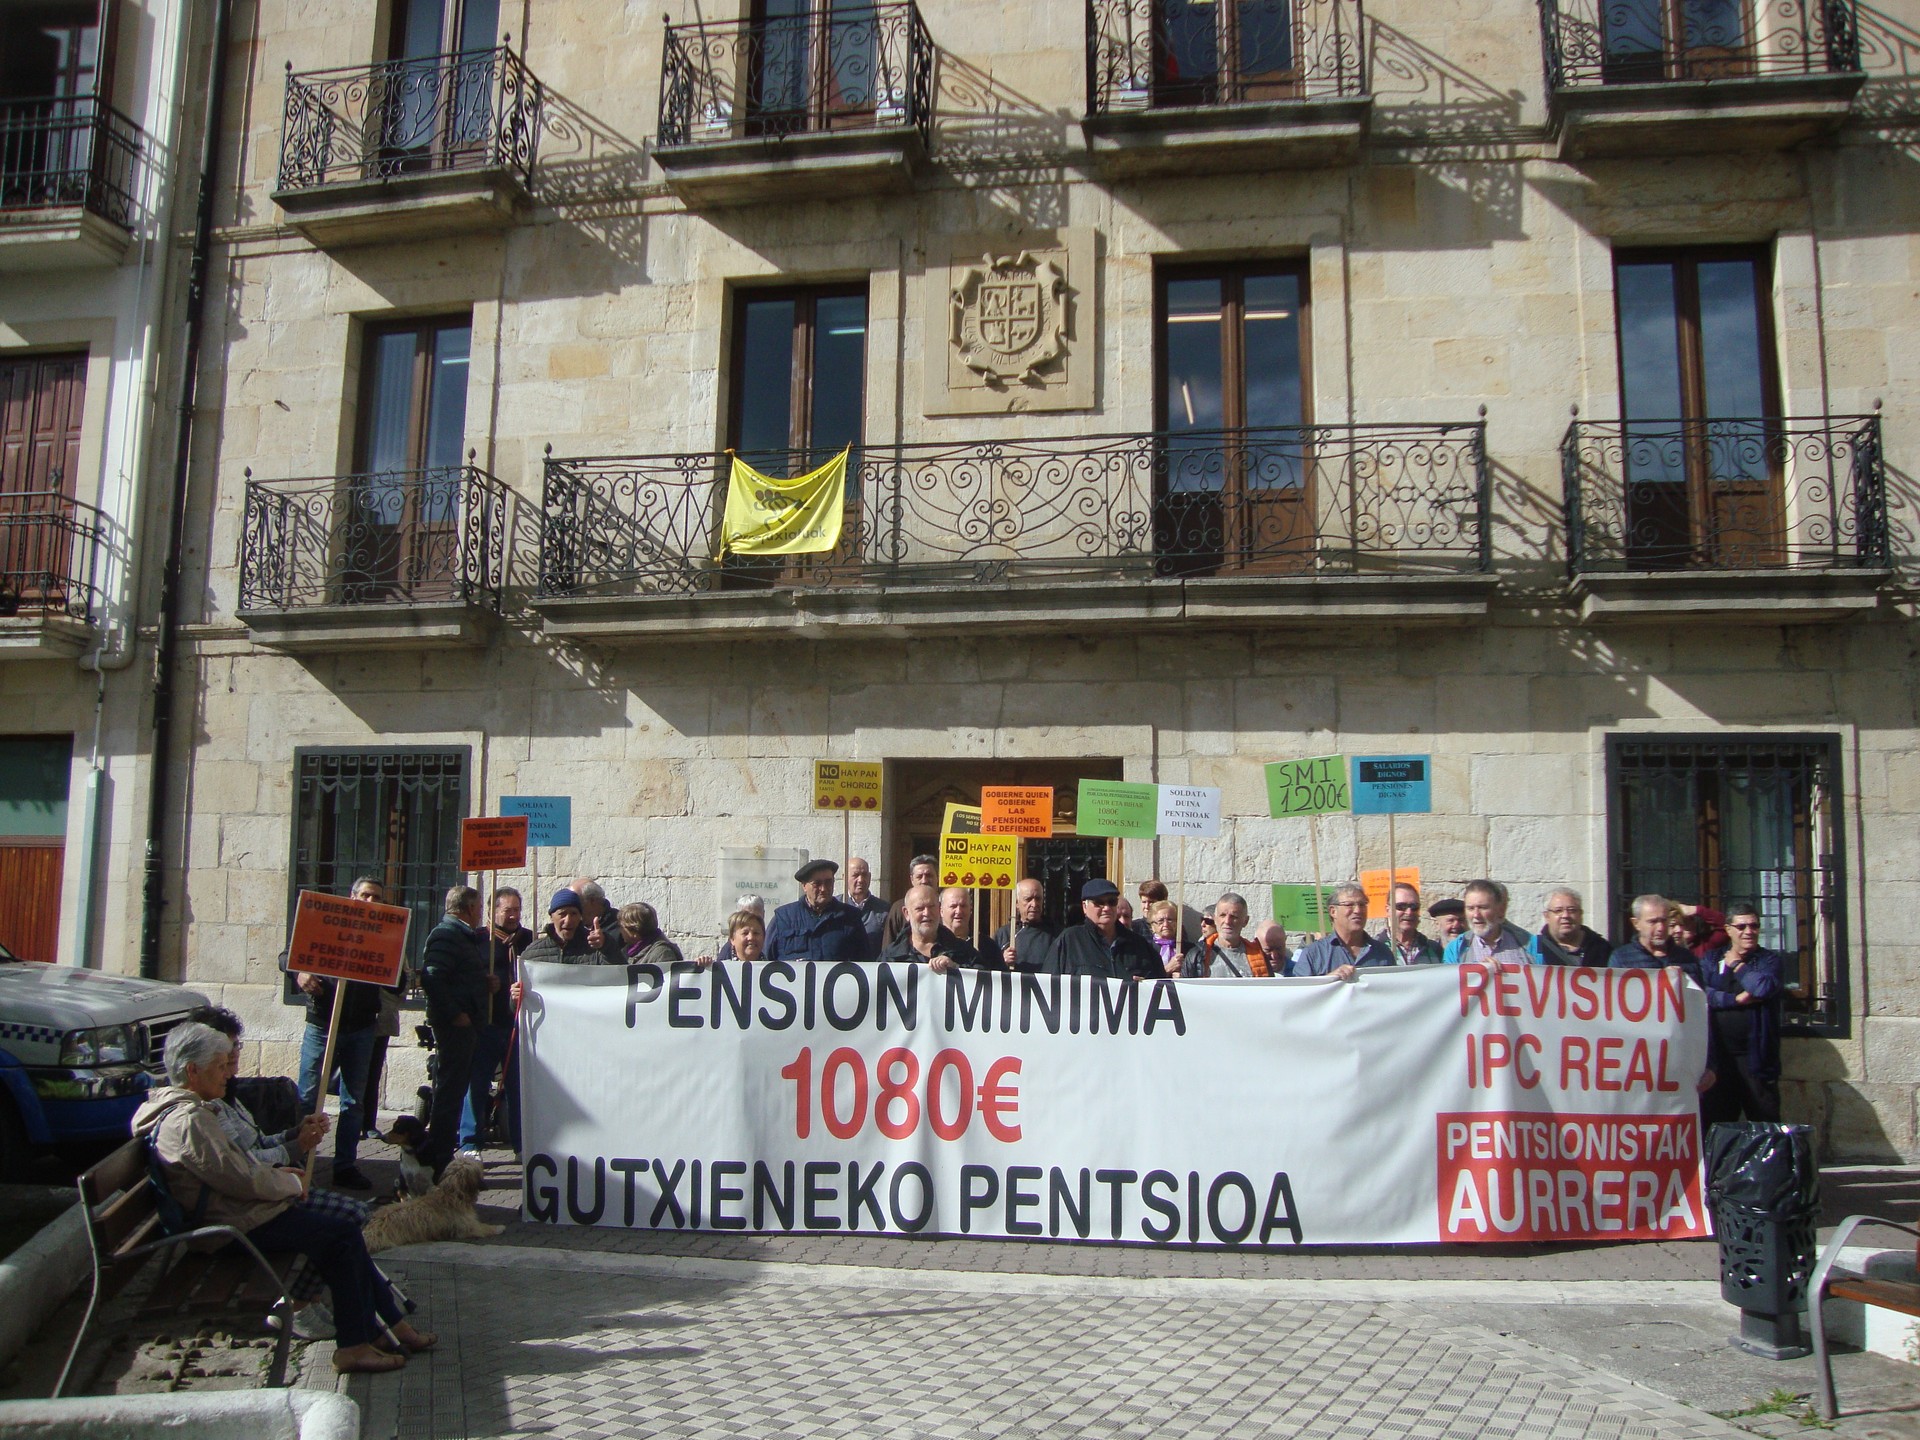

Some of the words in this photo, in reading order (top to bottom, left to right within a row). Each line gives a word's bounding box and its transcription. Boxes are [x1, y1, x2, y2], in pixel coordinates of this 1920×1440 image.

[820, 766, 838, 777] NO
[841, 769, 858, 777] HAY
[860, 770, 878, 778] PAN
[840, 781, 878, 790] CHORIZO
[1169, 789, 1207, 798] SOLDATA
[1175, 799, 1200, 808] DUINA
[1098, 807, 1119, 815] 1080€
[1165, 810, 1210, 819] PENTSIOAK
[1097, 818, 1119, 826] 1200€
[1171, 820, 1203, 829] DUINAK
[1000, 825, 1047, 833] DEFIENDEN
[948, 840, 967, 851] NO
[970, 843, 990, 851] HAY
[992, 844, 1012, 852] PAN
[969, 856, 1012, 866] CHORIZO
[735, 881, 779, 889] UDALETXEA
[304, 899, 365, 918] GOBIERNE
[368, 910, 405, 925] QUIEN
[322, 915, 383, 934] GOBIERNE
[337, 931, 364, 945] LAS
[309, 942, 385, 963] PENSIONES
[297, 953, 315, 966] SE
[318, 957, 392, 978] DEFIENDEN
[625, 961, 919, 1032] PENSION
[944, 966, 1187, 1037] MINIMA
[1458, 963, 1686, 1024] REVISION
[1466, 1033, 1542, 1090] IPC
[1560, 1036, 1680, 1093] REAL
[781, 1046, 1024, 1144] 1080€
[1446, 1120, 1691, 1161] PENTSIONISTAK
[526, 1153, 934, 1234] GUTXIENEKO
[960, 1164, 1304, 1245] PENTSIOA
[1447, 1168, 1697, 1234] AURRERA
